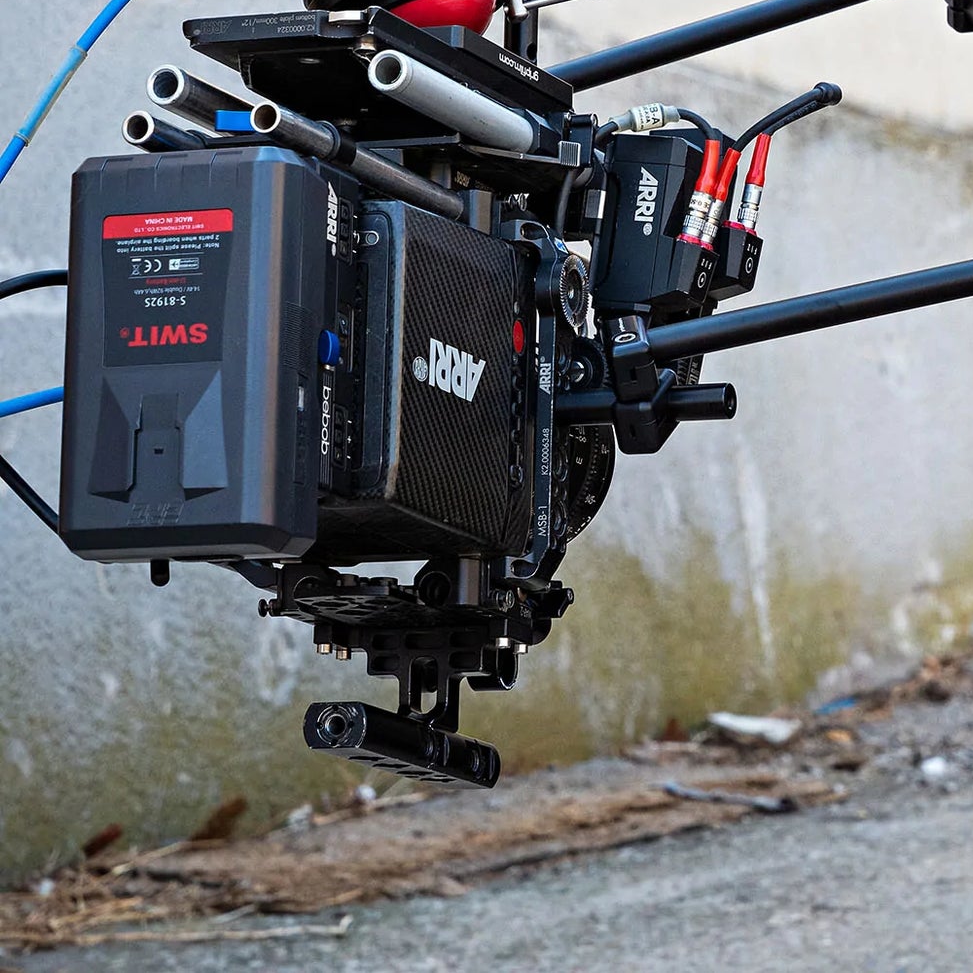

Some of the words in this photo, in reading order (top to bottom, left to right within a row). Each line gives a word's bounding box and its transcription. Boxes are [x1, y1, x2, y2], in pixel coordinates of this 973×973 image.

[280, 14, 294, 22] plate
[499, 53, 539, 82] gripfilm.com
[633, 166, 659, 223] ARRI
[156, 224, 190, 232] ELECTRONICS
[326, 182, 339, 247] ARRI
[154, 236, 180, 244] boarding
[181, 243, 202, 251] Please
[144, 296, 186, 307] S-8192S
[429, 338, 487, 403] ARRI
[539, 362, 552, 395] ARRI
[321, 386, 332, 456] bebob
[541, 427, 551, 476] K2.0006348
[538, 505, 549, 538] MSB-1
